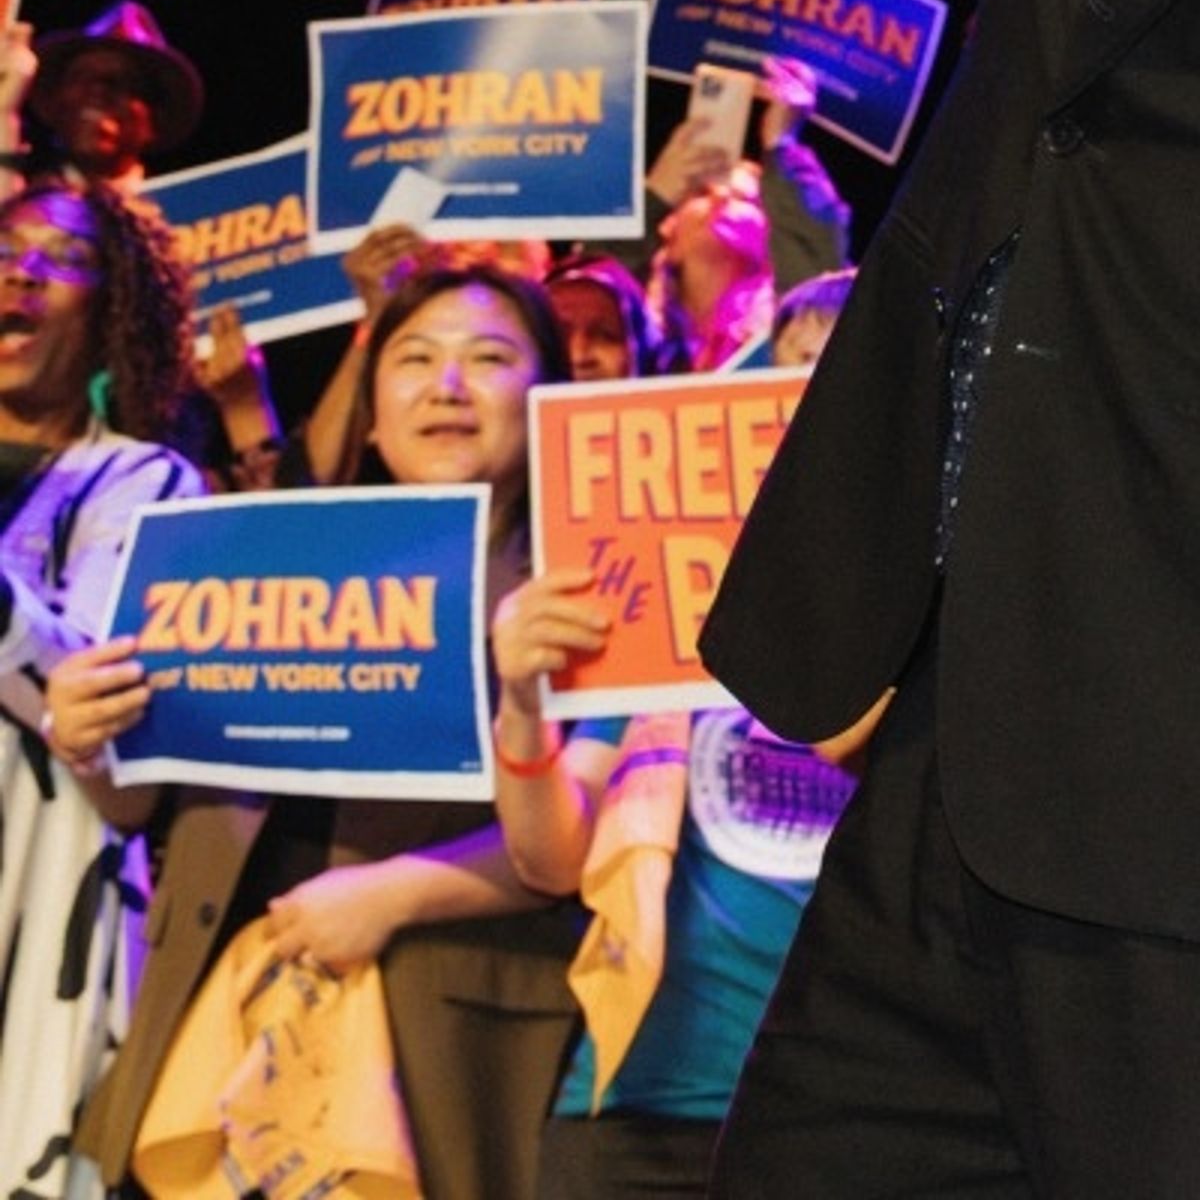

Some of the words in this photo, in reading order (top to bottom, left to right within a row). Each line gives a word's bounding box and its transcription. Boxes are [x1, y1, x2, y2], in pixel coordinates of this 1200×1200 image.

[343, 68, 604, 139] ZOHRAN
[524, 132, 588, 156] CITY
[167, 194, 307, 266] OHRA
[567, 395, 802, 523] FREE
[137, 576, 438, 652] ZOHRAN
[588, 537, 652, 624] THE
[186, 664, 258, 691] NEW
[262, 664, 345, 691] YORK
[349, 664, 421, 691] CITY
